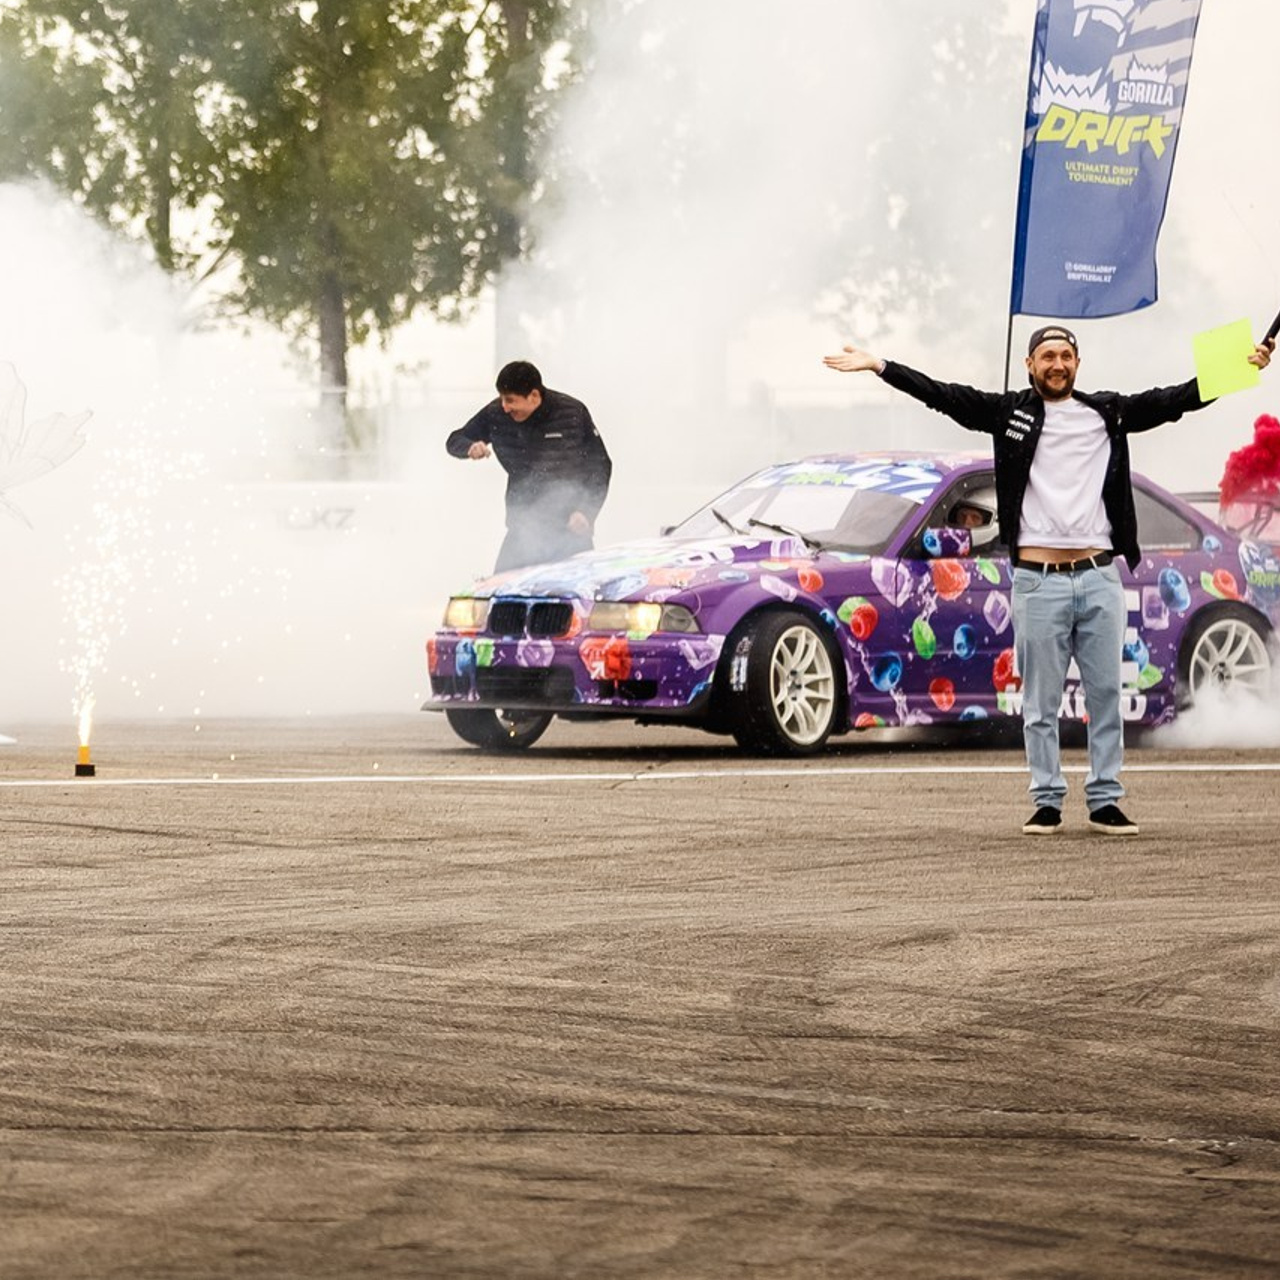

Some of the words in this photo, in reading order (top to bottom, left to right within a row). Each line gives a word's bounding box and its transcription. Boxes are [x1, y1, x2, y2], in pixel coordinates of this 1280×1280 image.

[1118, 81, 1174, 106] GORILLA
[1036, 104, 1172, 160] DRIFT
[1065, 161, 1109, 174] ULTIMATE
[1112, 165, 1139, 176] DRIFT
[1069, 172, 1133, 187] TOURNAMENT
